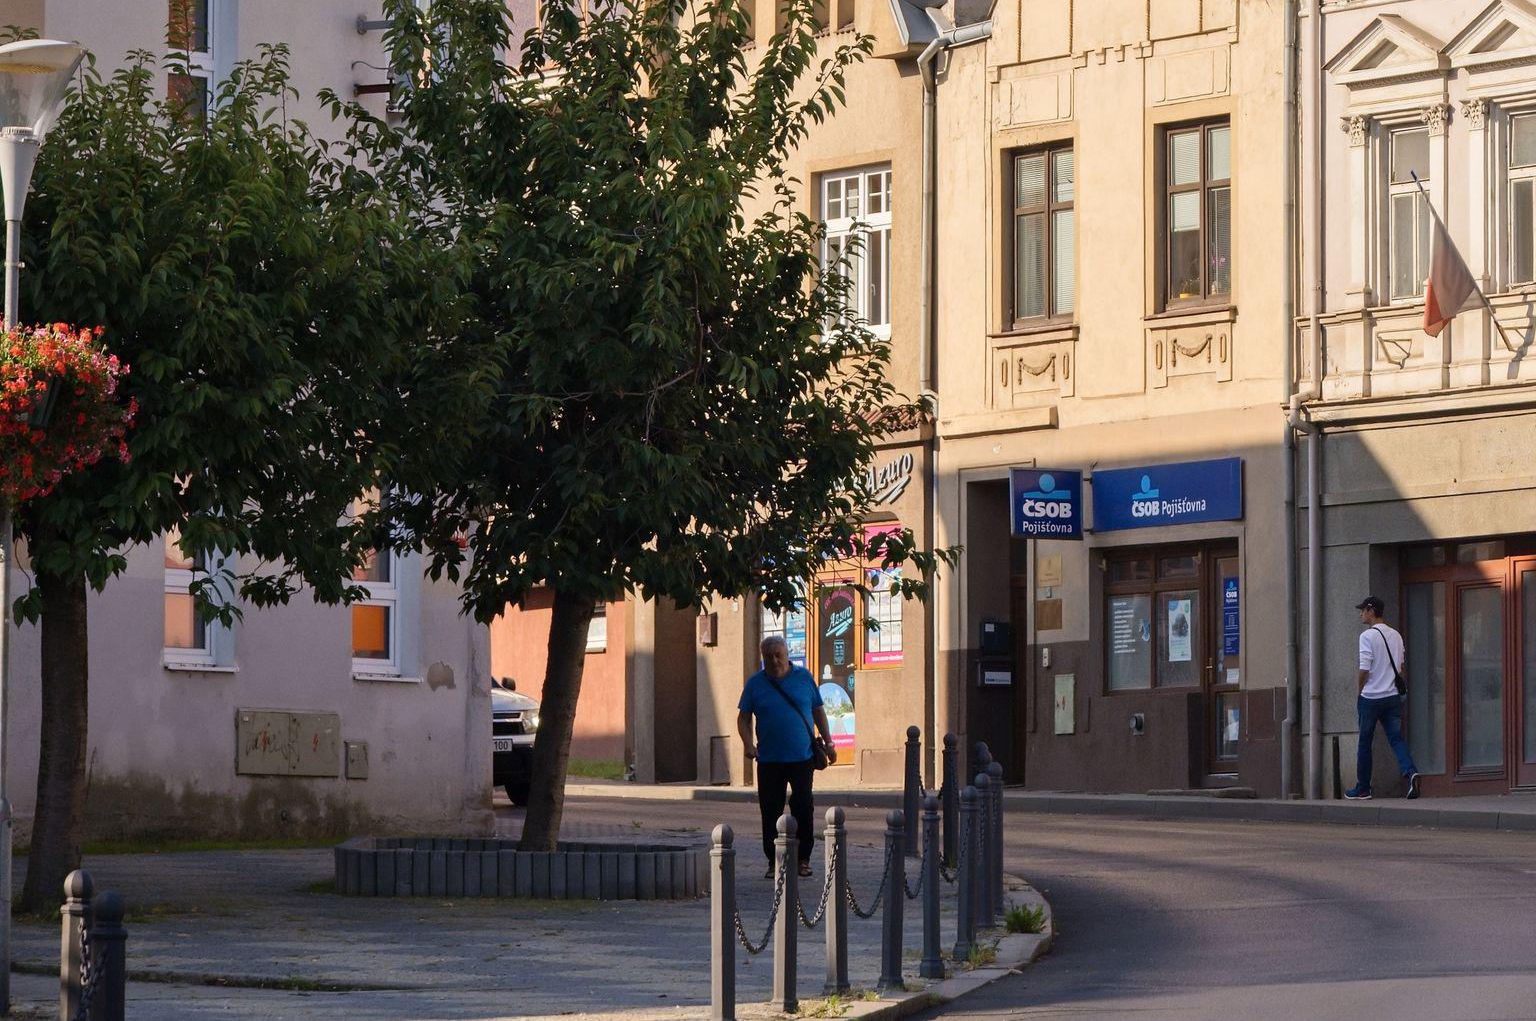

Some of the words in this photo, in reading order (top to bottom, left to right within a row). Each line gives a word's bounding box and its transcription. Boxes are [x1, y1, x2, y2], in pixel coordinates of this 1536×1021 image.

[1022, 499, 1073, 518] ČSOB
[1132, 500, 1160, 518] ČSOB
[1161, 497, 1206, 518] Pojišťovna
[1022, 521, 1073, 534] Pojišťovna
